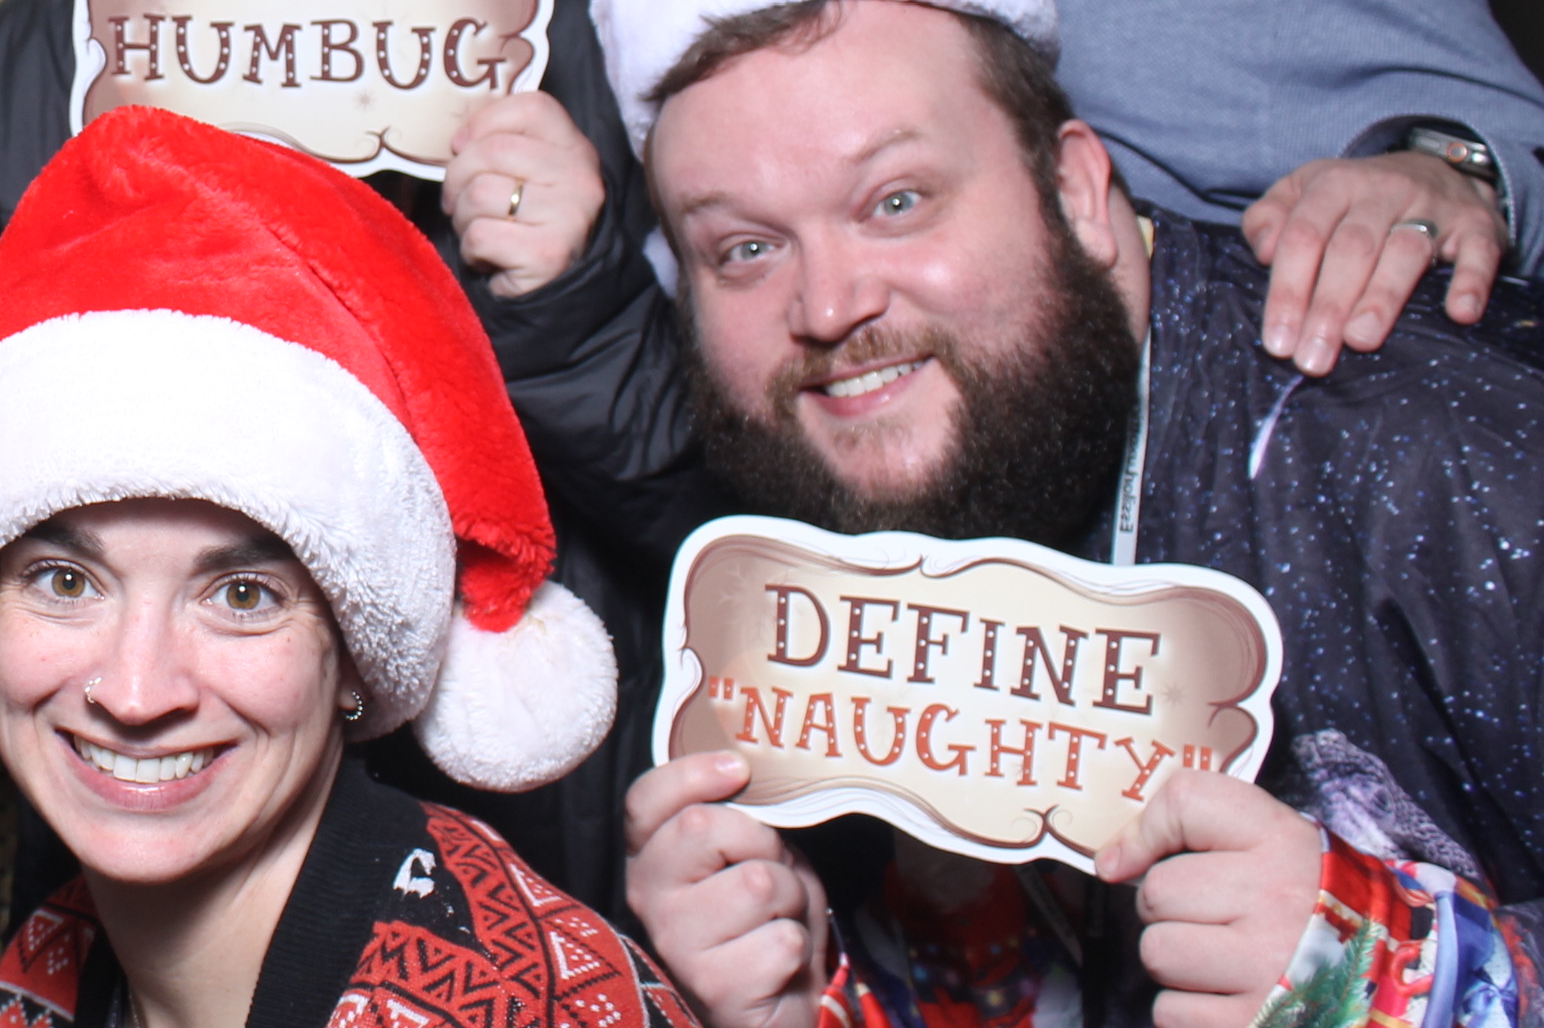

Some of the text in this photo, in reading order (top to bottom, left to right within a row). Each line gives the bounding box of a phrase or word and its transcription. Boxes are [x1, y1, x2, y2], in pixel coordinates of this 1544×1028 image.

[107, 13, 507, 91] HUMBUG
[764, 583, 1161, 716] DEFINE
[707, 677, 1213, 803] "NAUGHTY"
